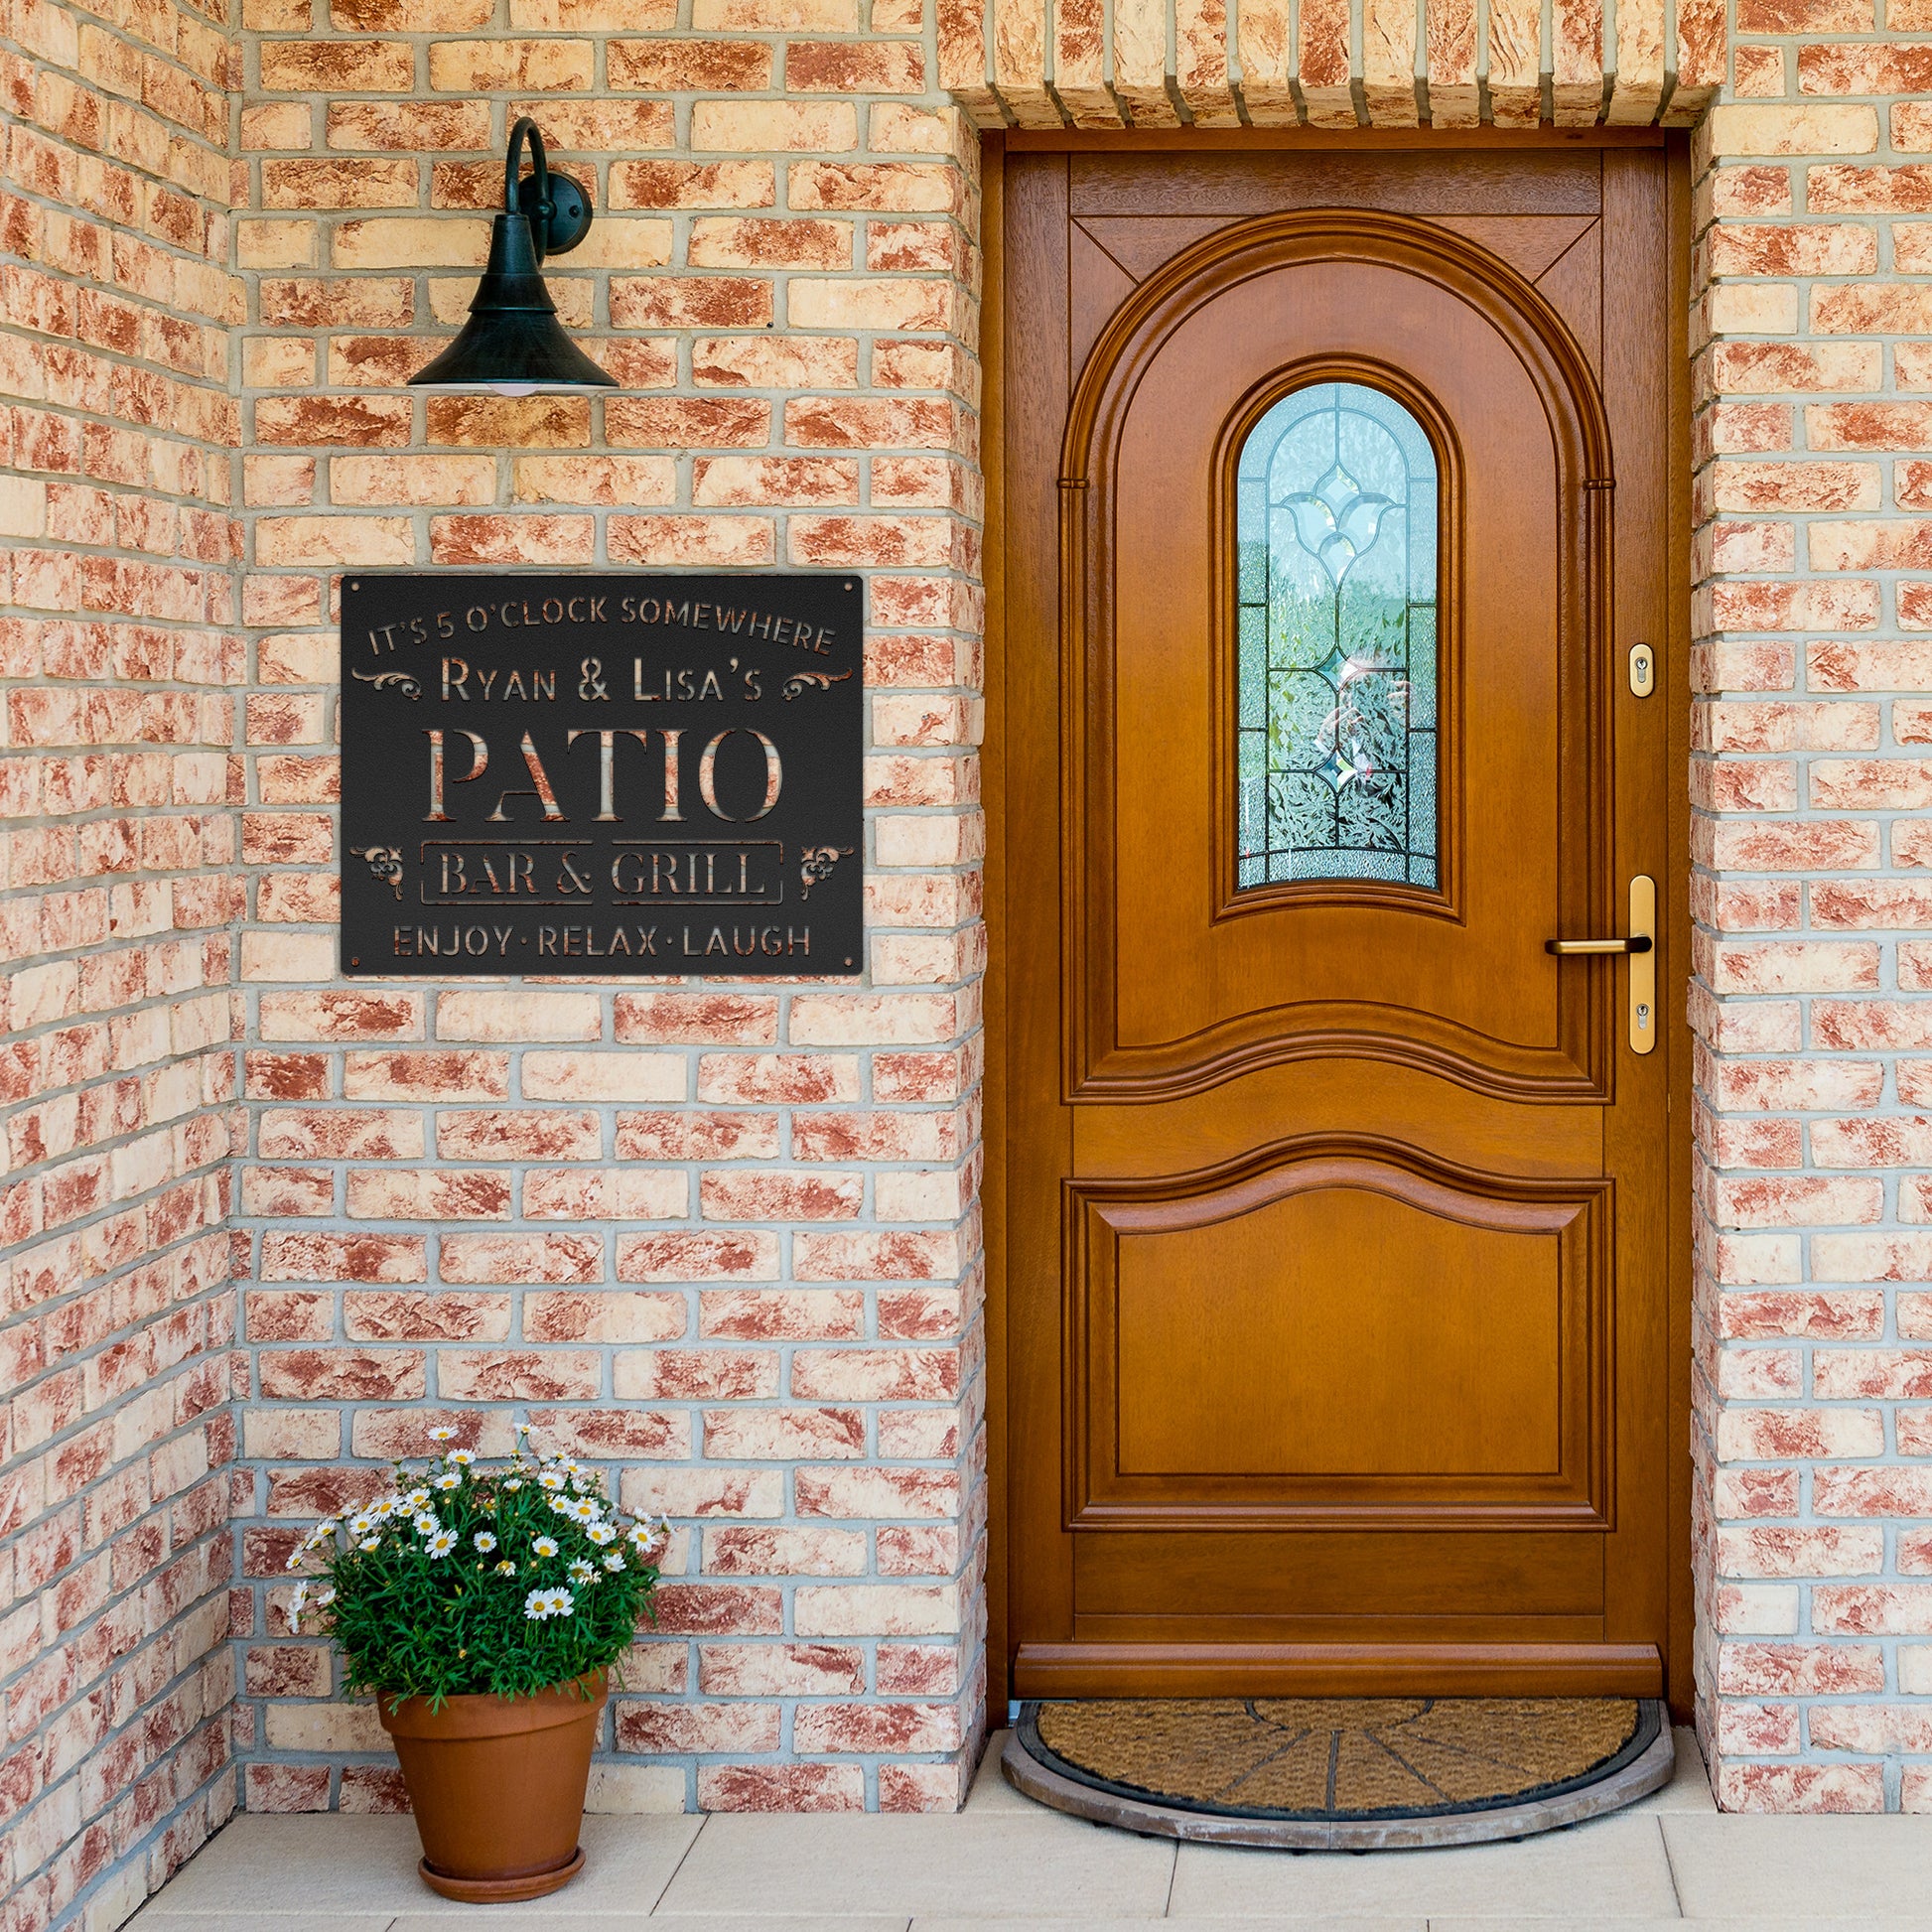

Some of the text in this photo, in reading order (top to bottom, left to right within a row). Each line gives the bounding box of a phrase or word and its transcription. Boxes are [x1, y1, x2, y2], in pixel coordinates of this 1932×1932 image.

[368, 597, 835, 655] IT'S 5 O'CLOCK SOMEWHERE
[442, 657, 761, 701] RYAN & LISA'S
[422, 729, 783, 822] PATIO
[440, 852, 765, 894] BAR & GRILL
[394, 926, 810, 956] ENJOY RELAX LAUGH
